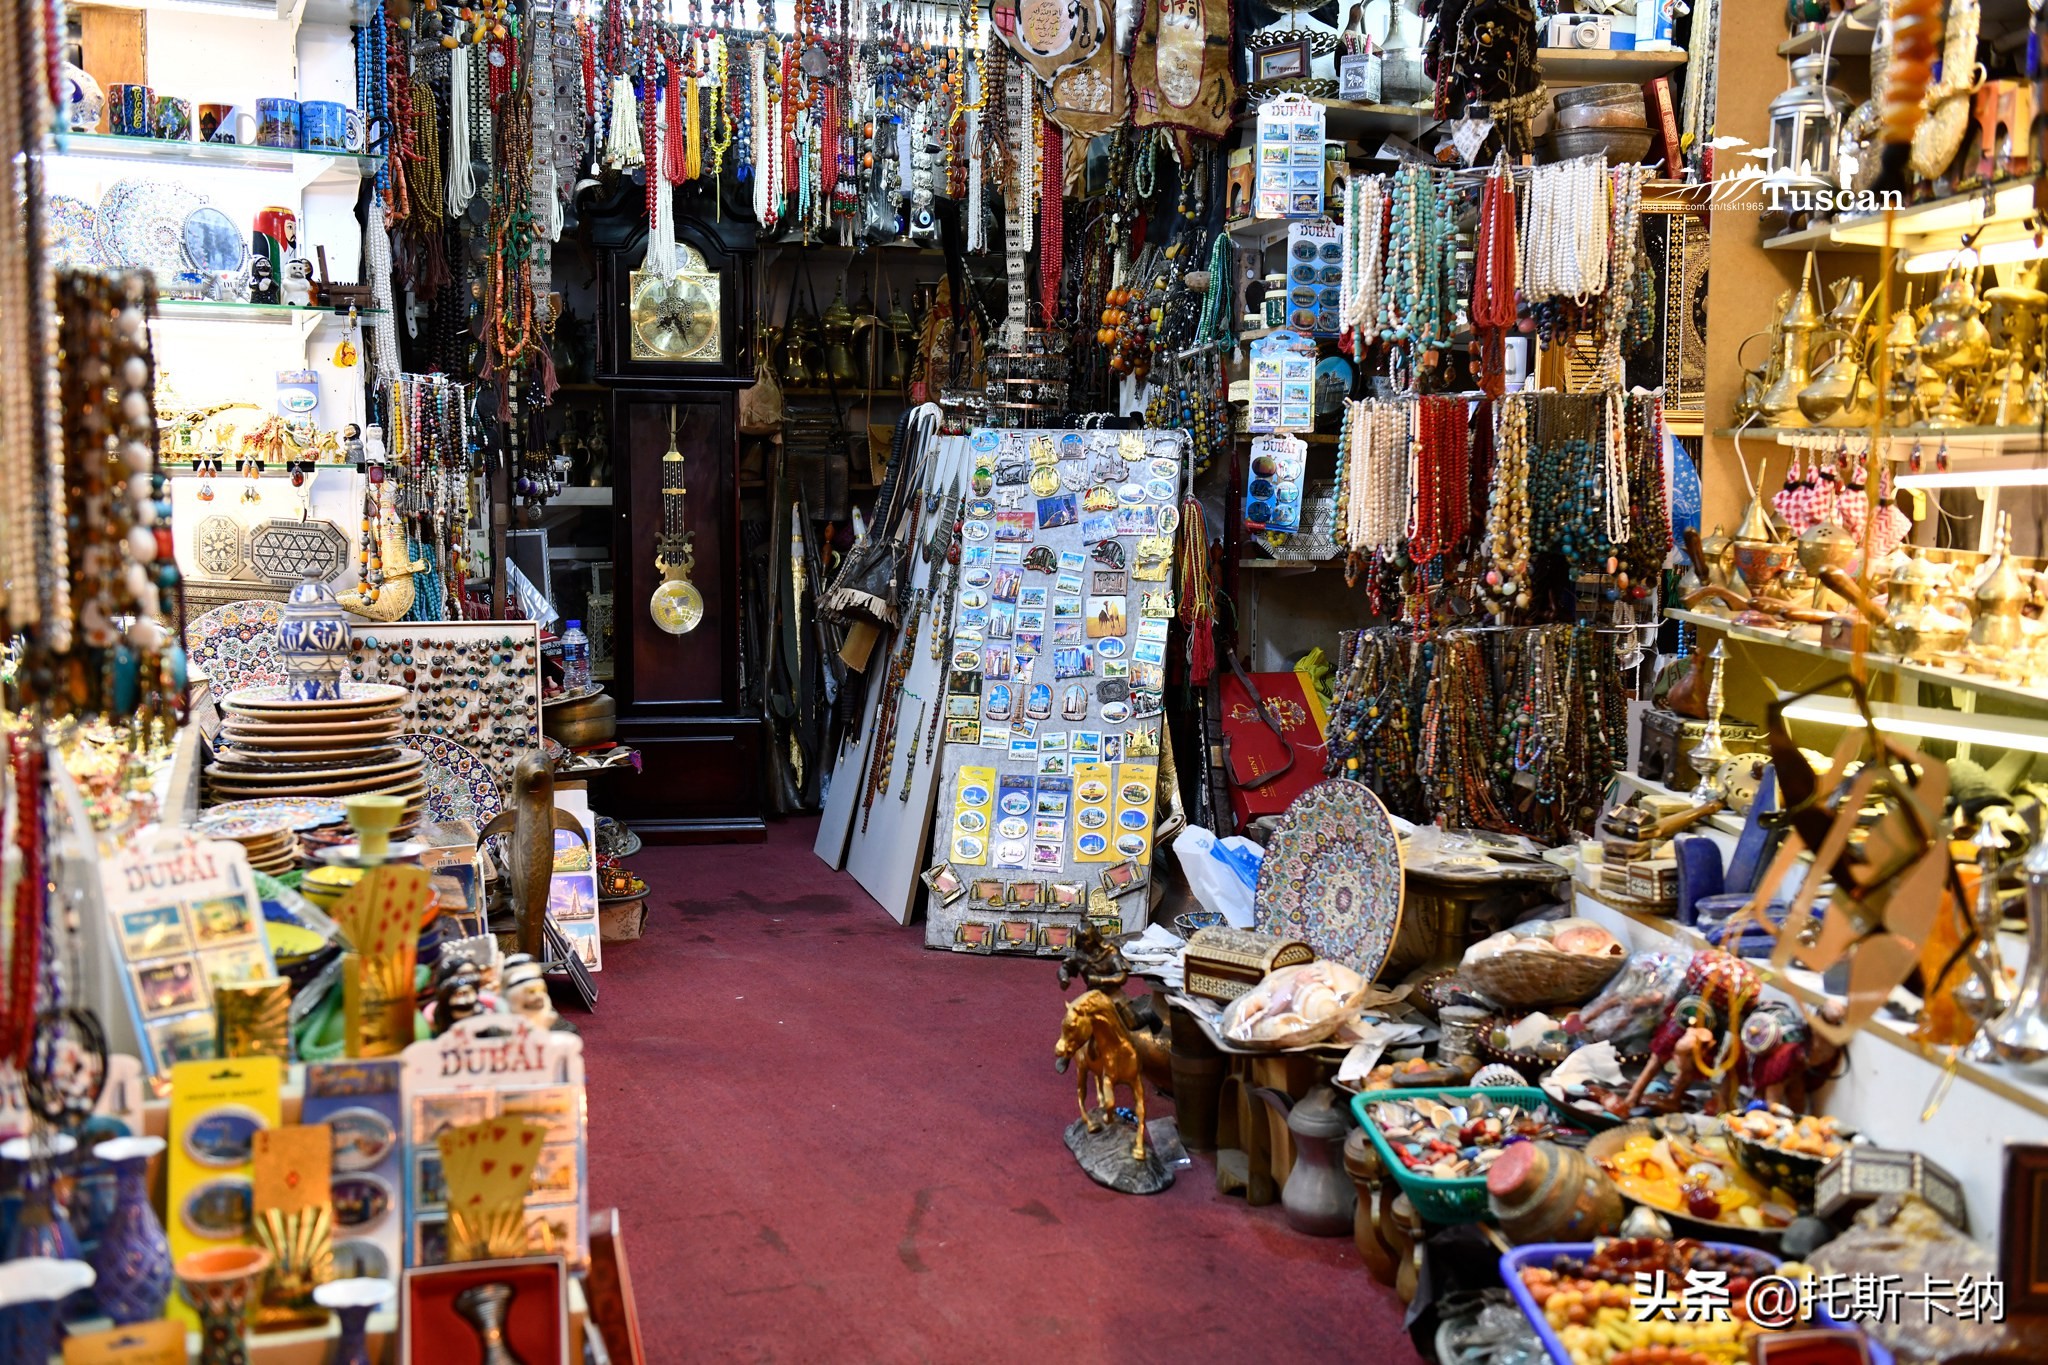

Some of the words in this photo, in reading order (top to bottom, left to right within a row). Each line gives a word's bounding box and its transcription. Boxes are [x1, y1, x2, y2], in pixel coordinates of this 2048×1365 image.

[1272, 105, 1312, 117] DUBAI
[1300, 225, 1336, 239] DUBAI
[1262, 440, 1296, 454] DUBAI
[1247, 754, 1268, 798] ORMENT
[437, 858, 461, 866] DUBAI
[124, 854, 218, 892] DUBAI
[441, 1045, 546, 1076] DUBAI
